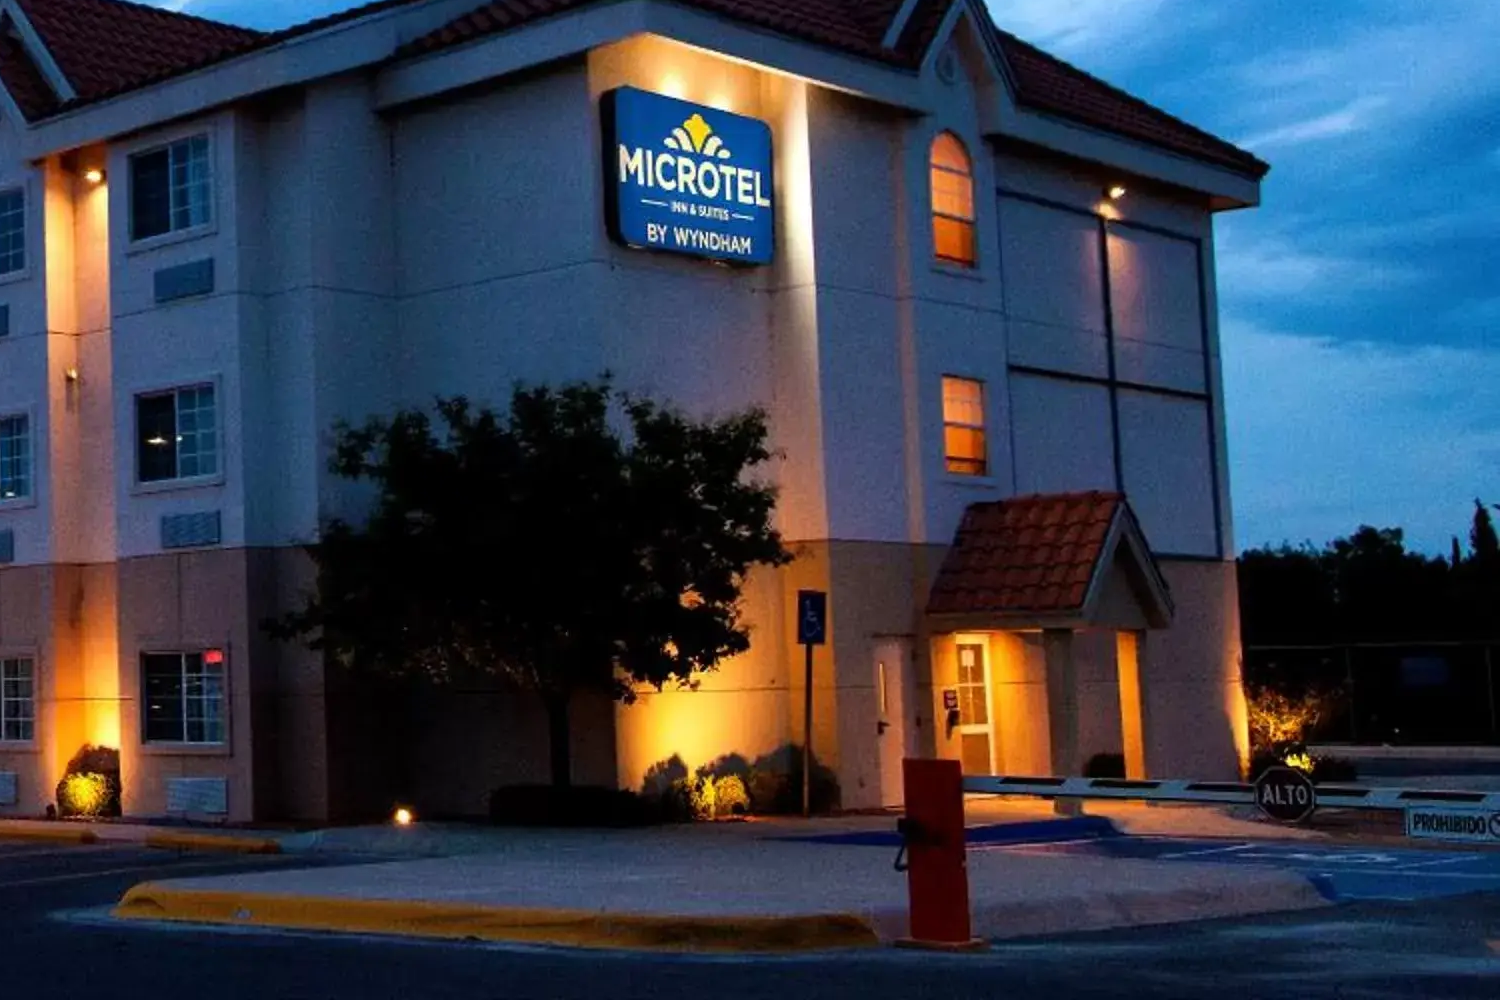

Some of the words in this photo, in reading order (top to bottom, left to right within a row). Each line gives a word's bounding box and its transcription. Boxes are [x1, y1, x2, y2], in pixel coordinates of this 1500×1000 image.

[618, 143, 771, 207] MICROTEL
[647, 223, 667, 244] BY
[673, 226, 752, 255] WYNDHAM
[1262, 784, 1308, 806] ALTO
[1413, 813, 1487, 834] PROHIBIDO
